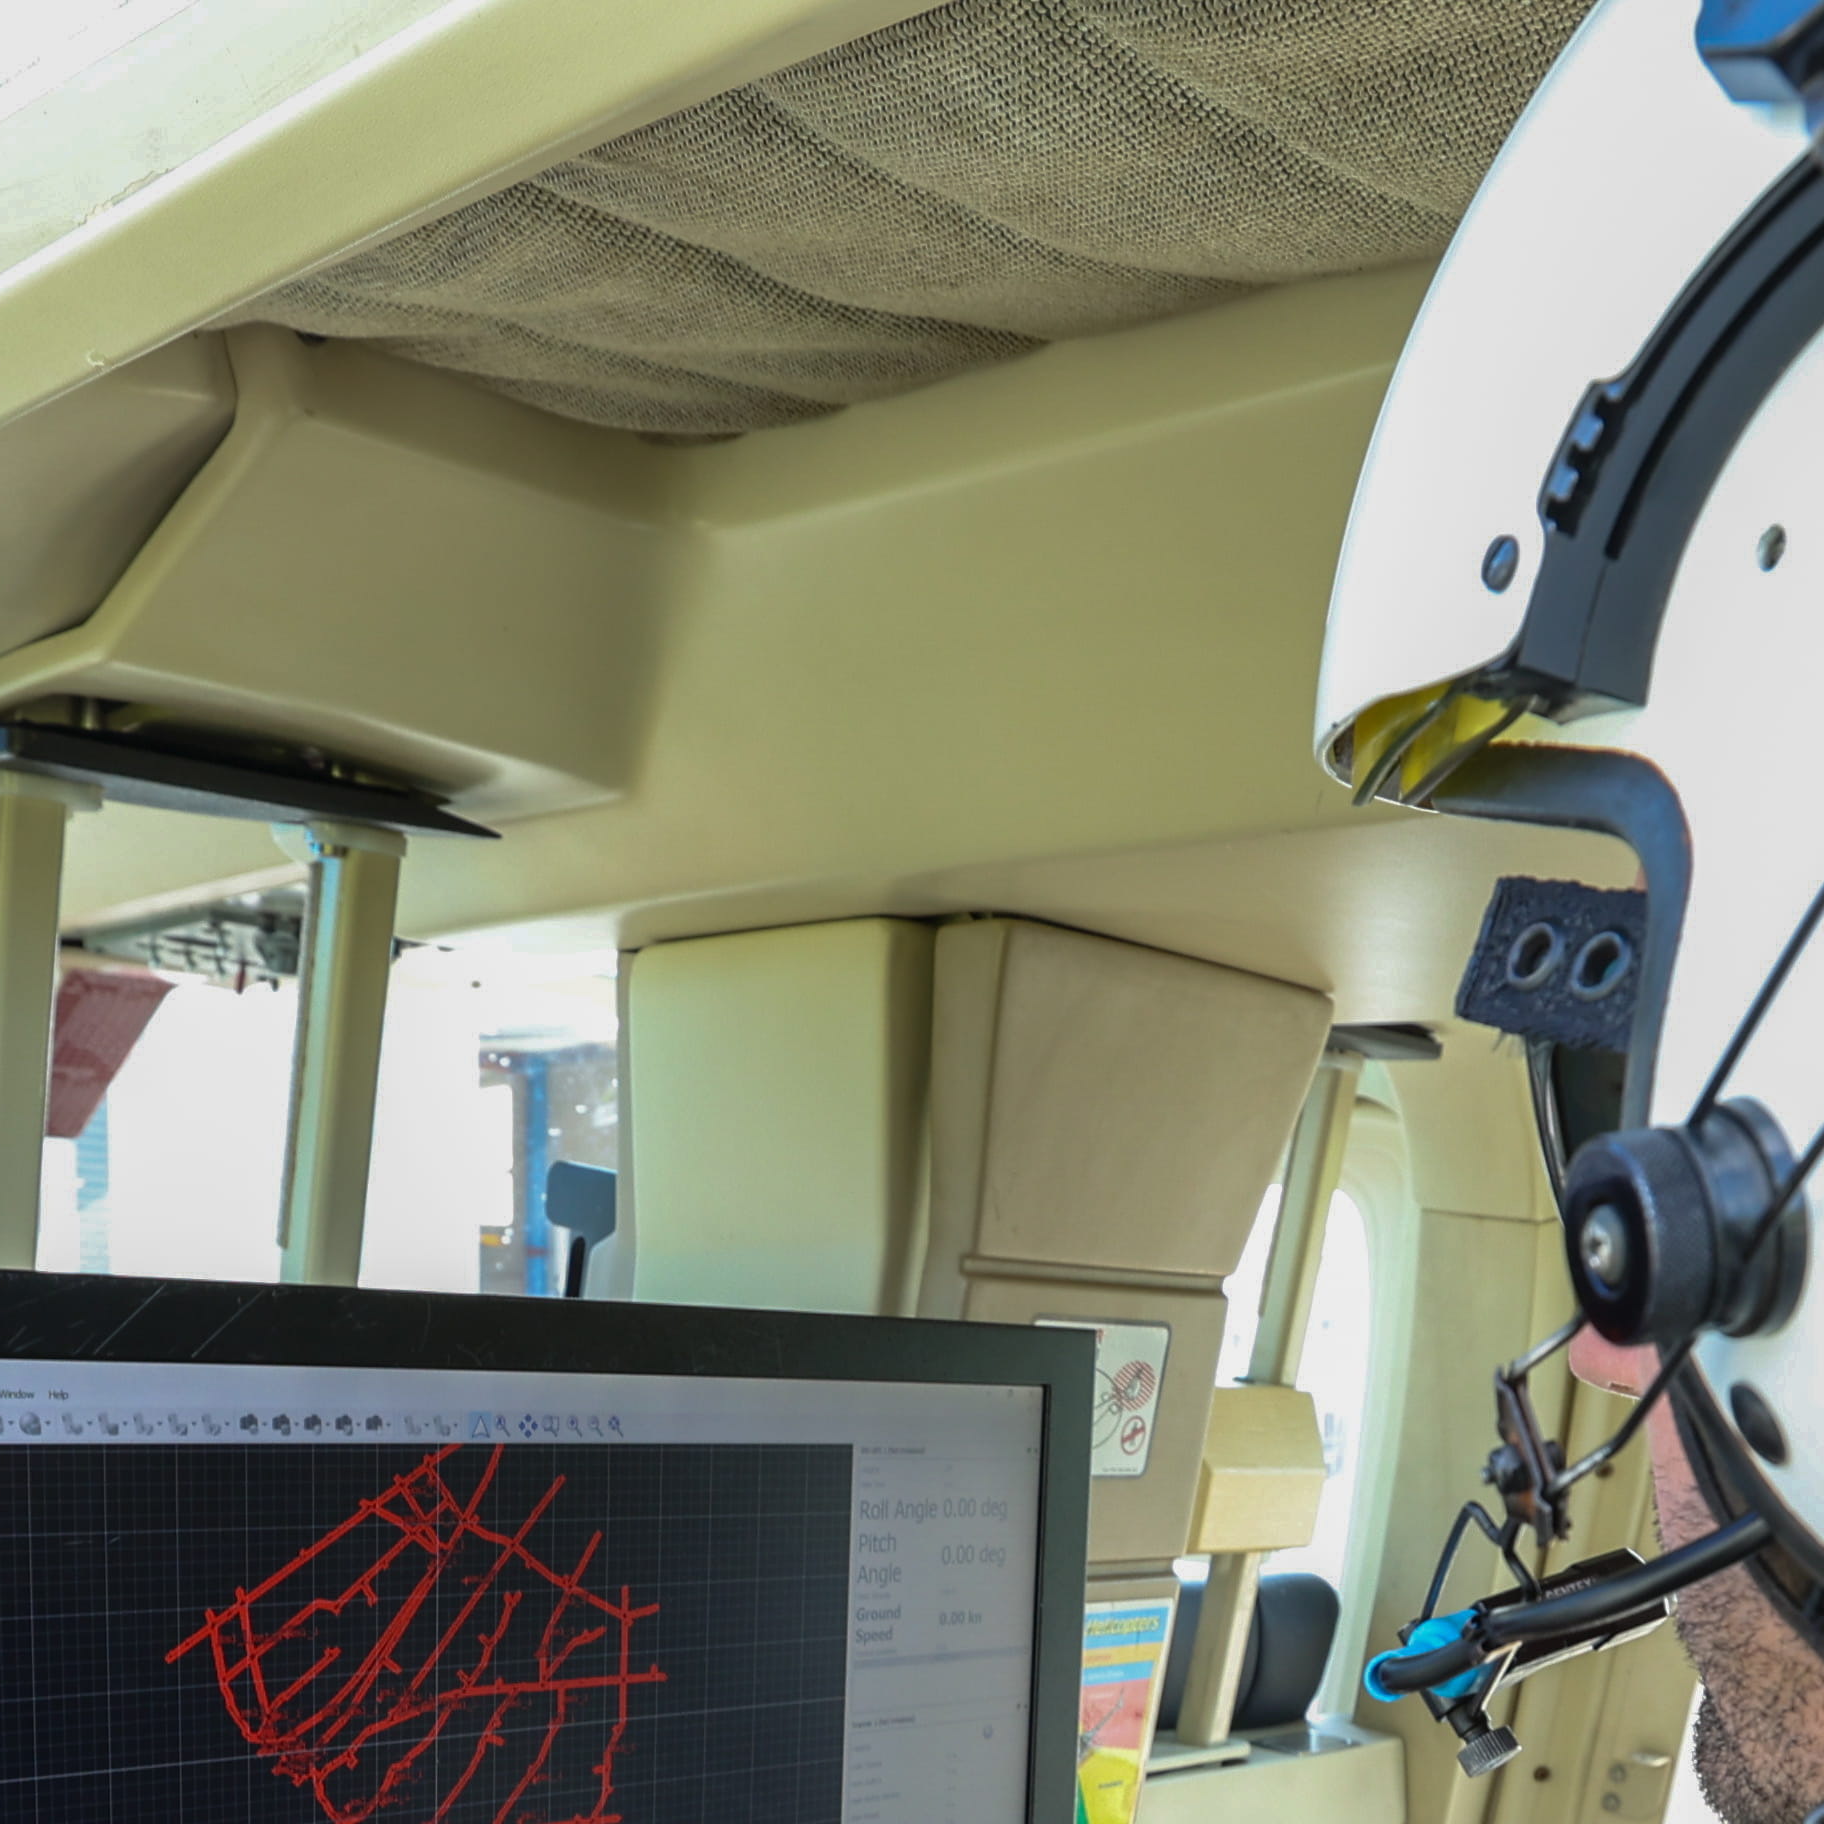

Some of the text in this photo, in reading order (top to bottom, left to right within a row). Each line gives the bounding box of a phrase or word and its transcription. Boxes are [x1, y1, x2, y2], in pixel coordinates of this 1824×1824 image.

[48, 1390, 69, 1401] Help
[859, 1498, 1007, 1524] Roll Angle 0.00 deg
[858, 1533, 897, 1552] Pitch
[941, 1545, 1007, 1567] 0.00 deg
[857, 1564, 902, 1588] Angle
[856, 1605, 902, 1622] Ground
[855, 1627, 894, 1647] Speed
